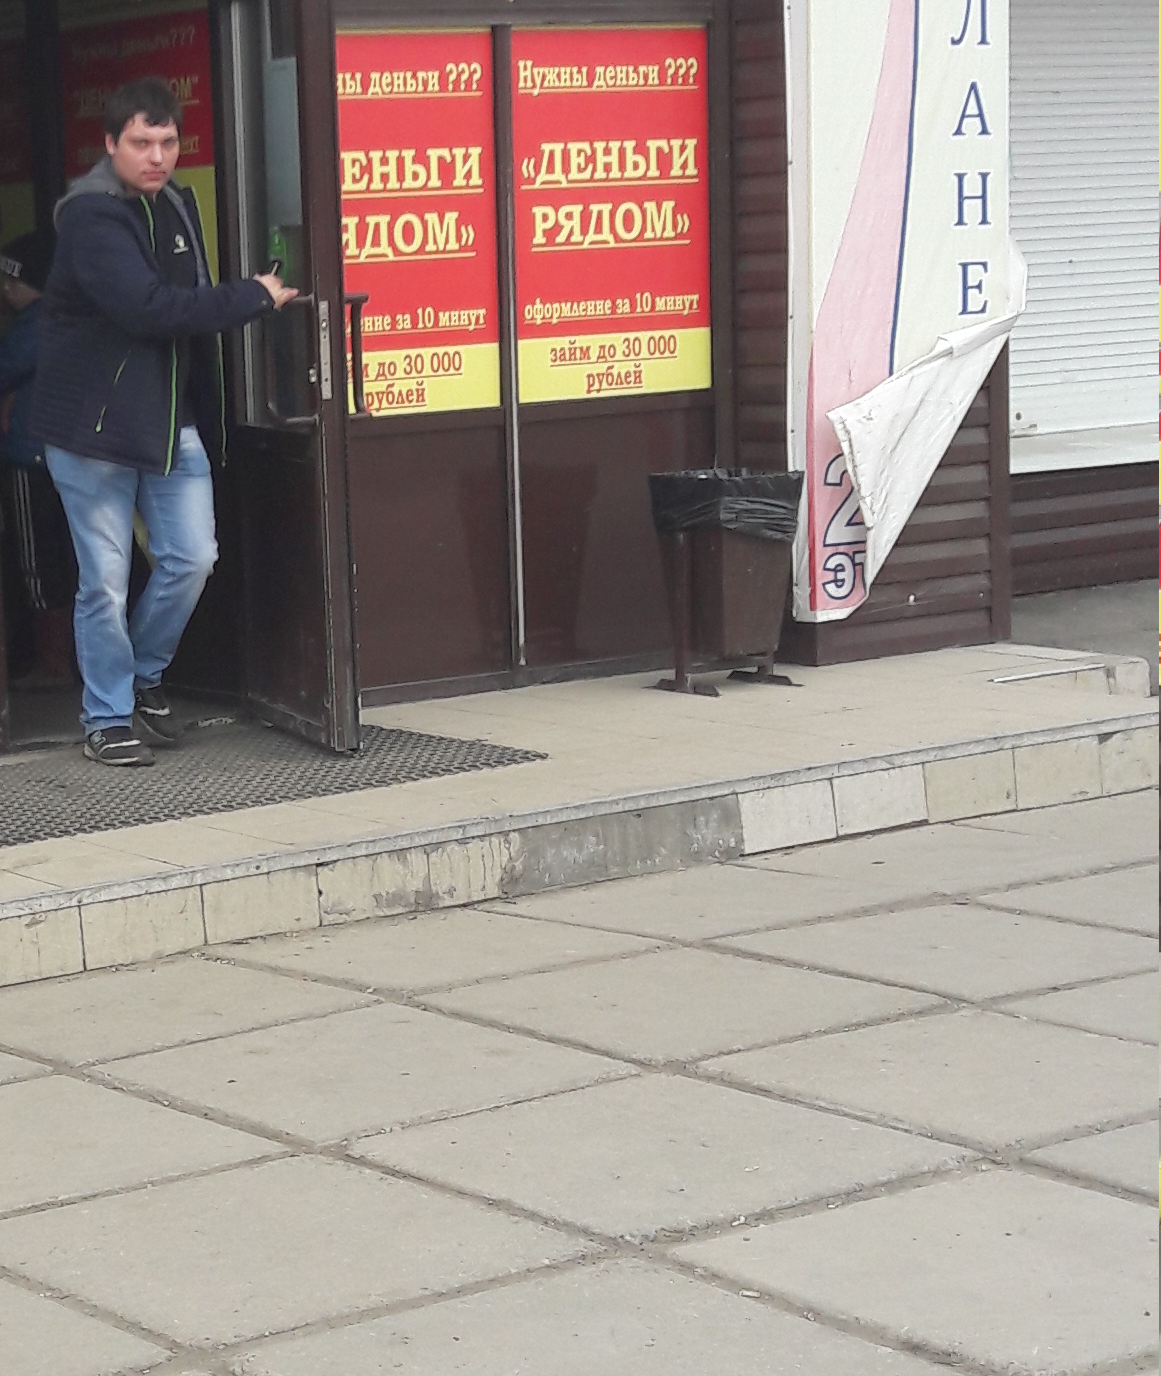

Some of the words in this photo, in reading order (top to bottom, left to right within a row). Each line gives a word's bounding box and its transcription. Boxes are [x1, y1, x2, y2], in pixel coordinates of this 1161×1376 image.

[368, 70, 440, 97] деньги
[445, 62, 482, 91] ???
[518, 59, 588, 96] Нужны
[592, 64, 659, 90] деньги
[665, 57, 698, 85] ???
[340, 146, 483, 192] ЕНЬГИ
[521, 137, 699, 187] «ДЕНЬГИ
[341, 210, 475, 261] ЯДОМ»
[532, 200, 690, 247] РЯДОМ»
[395, 312, 412, 331] за
[416, 306, 435, 329] 10
[439, 308, 486, 333] минут
[524, 298, 612, 325] оформление
[616, 297, 631, 315] за
[635, 291, 652, 313] 10
[655, 294, 699, 316] минут
[375, 361, 397, 381] до
[403, 353, 425, 375] 30
[430, 351, 462, 373] 000
[550, 340, 591, 363] займ
[597, 343, 617, 363] до
[622, 337, 642, 358] 30
[647, 334, 677, 356] 000
[365, 380, 426, 412] рублей
[586, 363, 643, 395] рублей
[823, 452, 867, 548] 2
